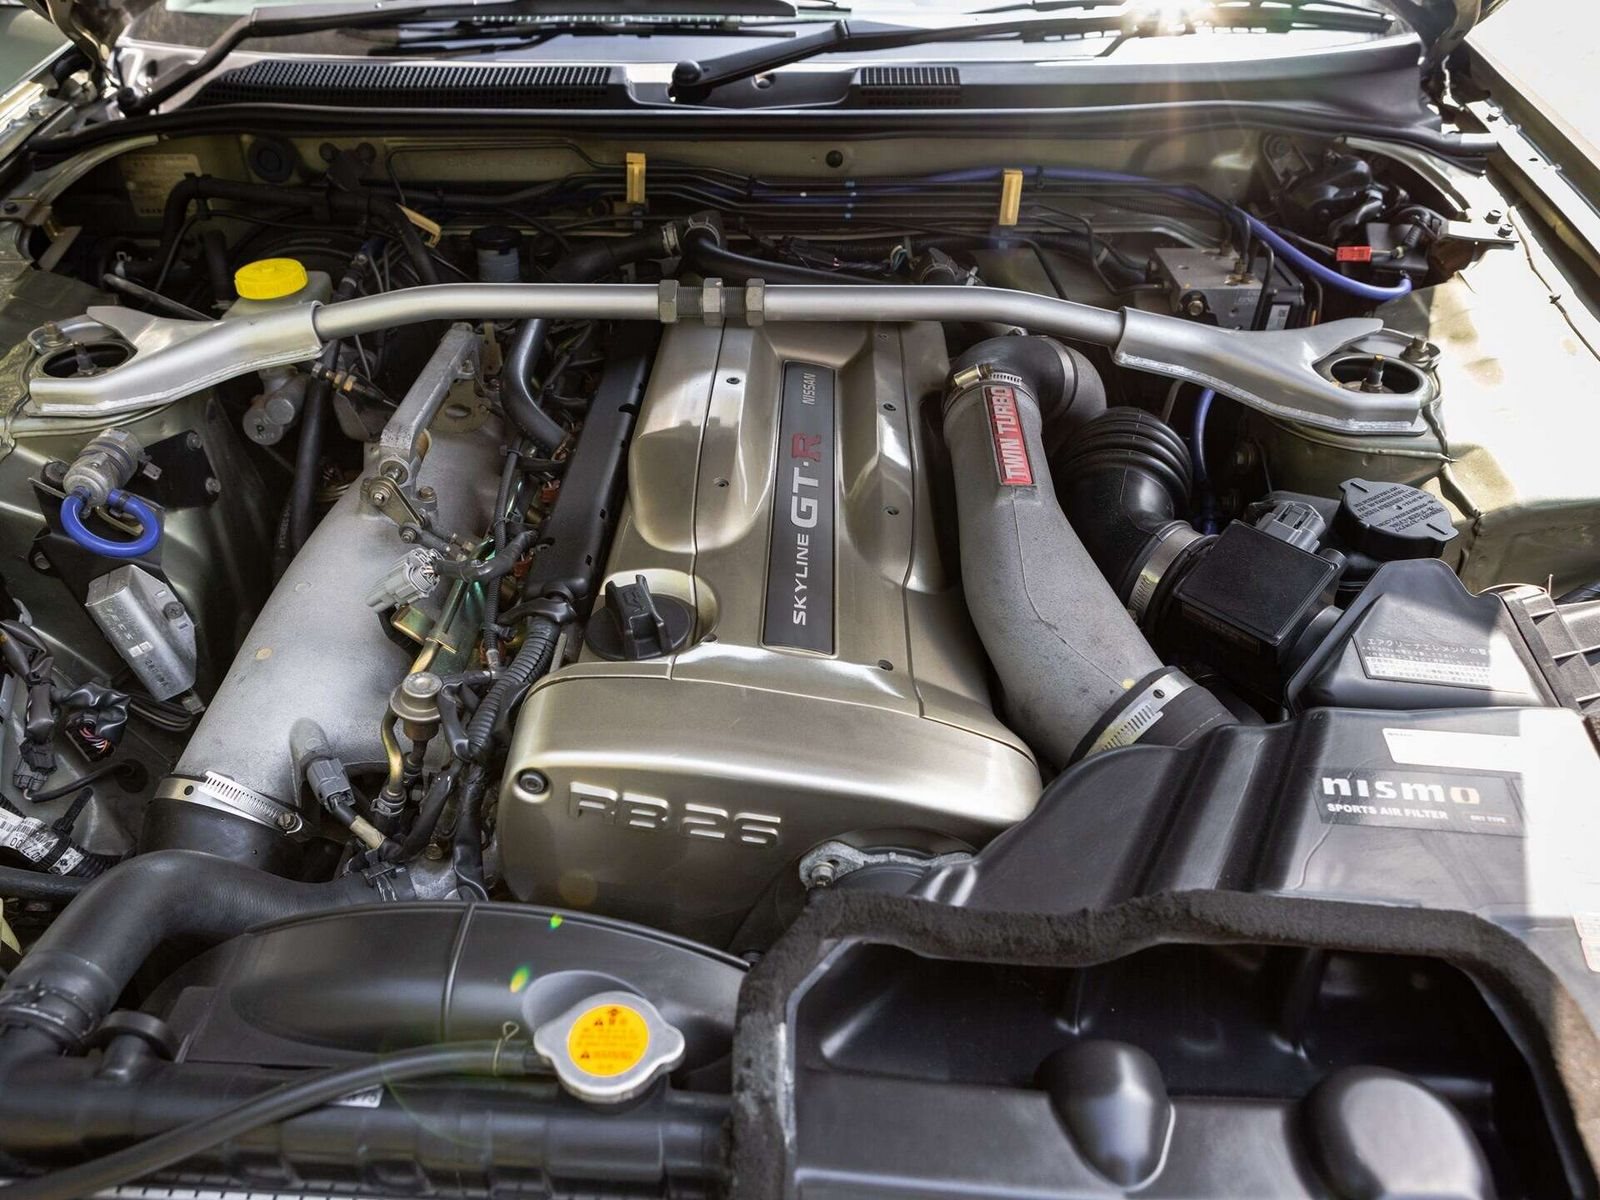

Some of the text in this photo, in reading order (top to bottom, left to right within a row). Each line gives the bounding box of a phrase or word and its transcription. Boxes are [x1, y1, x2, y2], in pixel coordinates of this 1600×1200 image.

[802, 373, 816, 405] NISSAN
[991, 387, 1026, 479] TWIN TURBO
[793, 533, 809, 626] SKYLINE
[568, 781, 782, 848] RB26
[1322, 777, 1480, 805] nismo
[1327, 803, 1449, 820] SPORTS AIR FILTER
